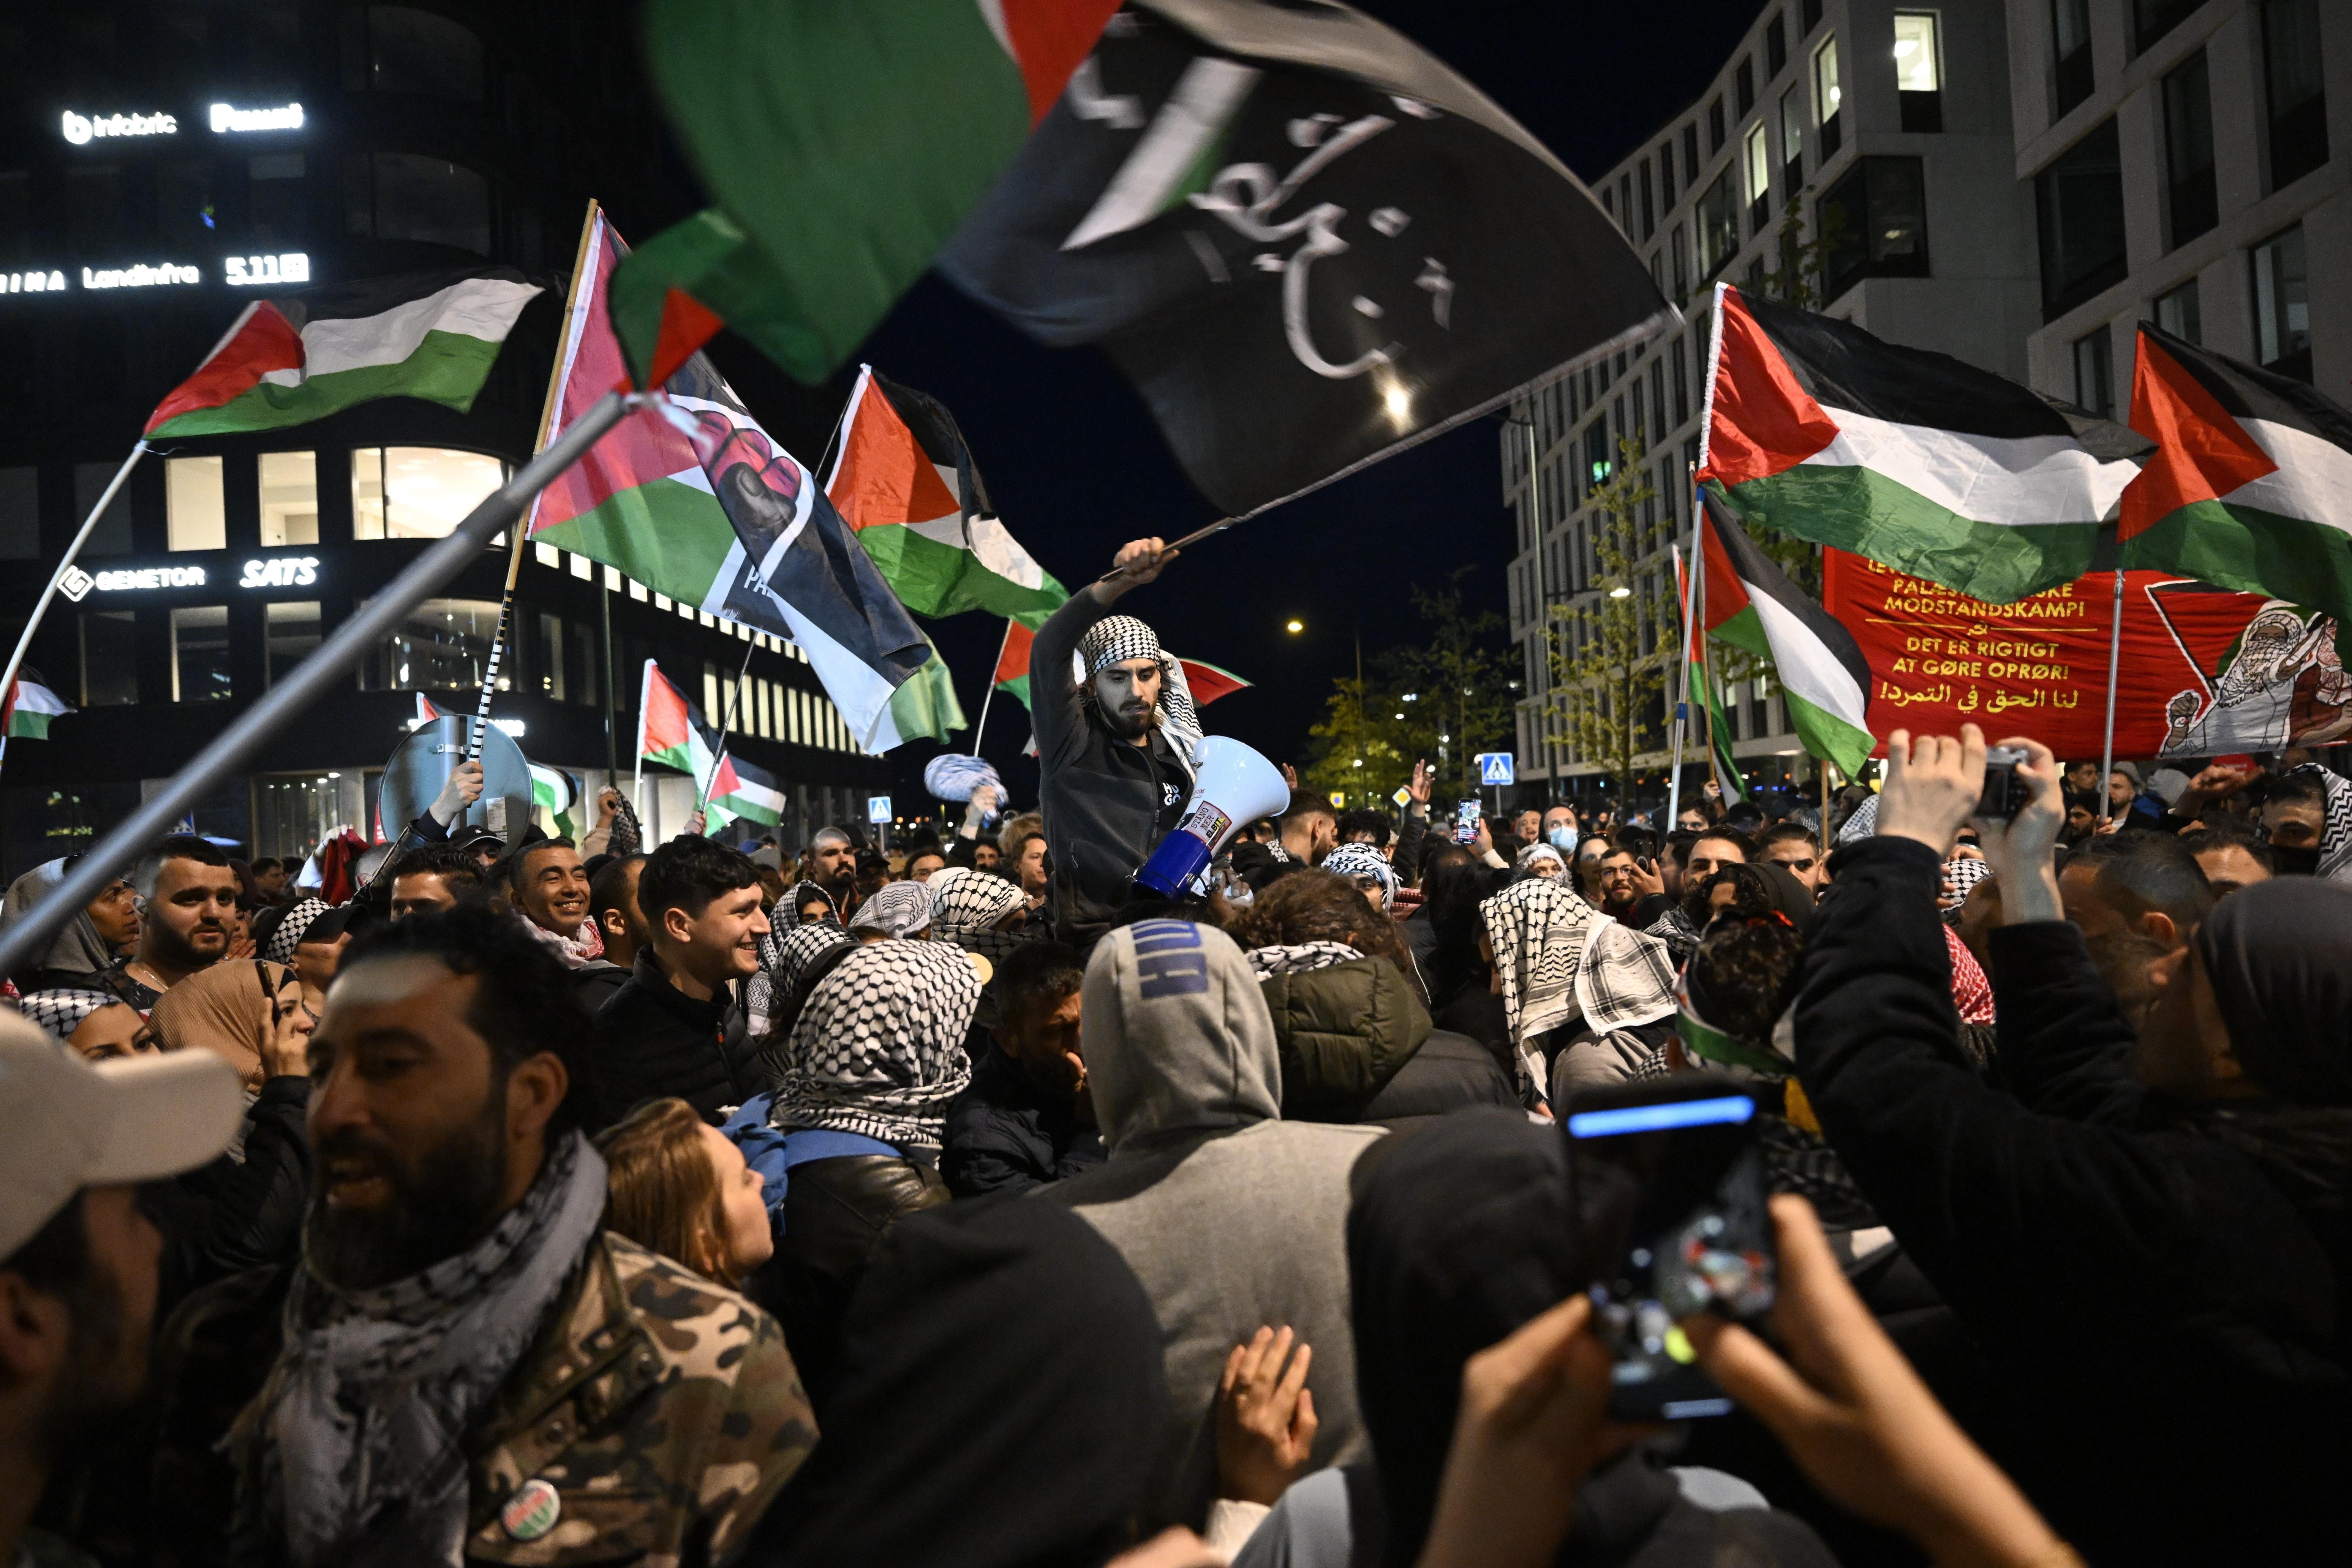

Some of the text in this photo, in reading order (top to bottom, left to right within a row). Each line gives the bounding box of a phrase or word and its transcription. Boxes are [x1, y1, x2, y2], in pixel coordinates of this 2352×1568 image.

[84, 263, 199, 289] Landinfra
[240, 557, 319, 588] SATS
[744, 564, 774, 599] PA
[1907, 637, 2059, 658] DET ER RIGTIGT
[1892, 658, 2069, 680] AT GØRE OPRØR!
[1958, 684, 1978, 714] في
[1986, 688, 2045, 713] الحق
[2053, 689, 2079, 708] لنا
[1200, 815, 1214, 831] NER
[1206, 817, 1222, 839] ELBIT
